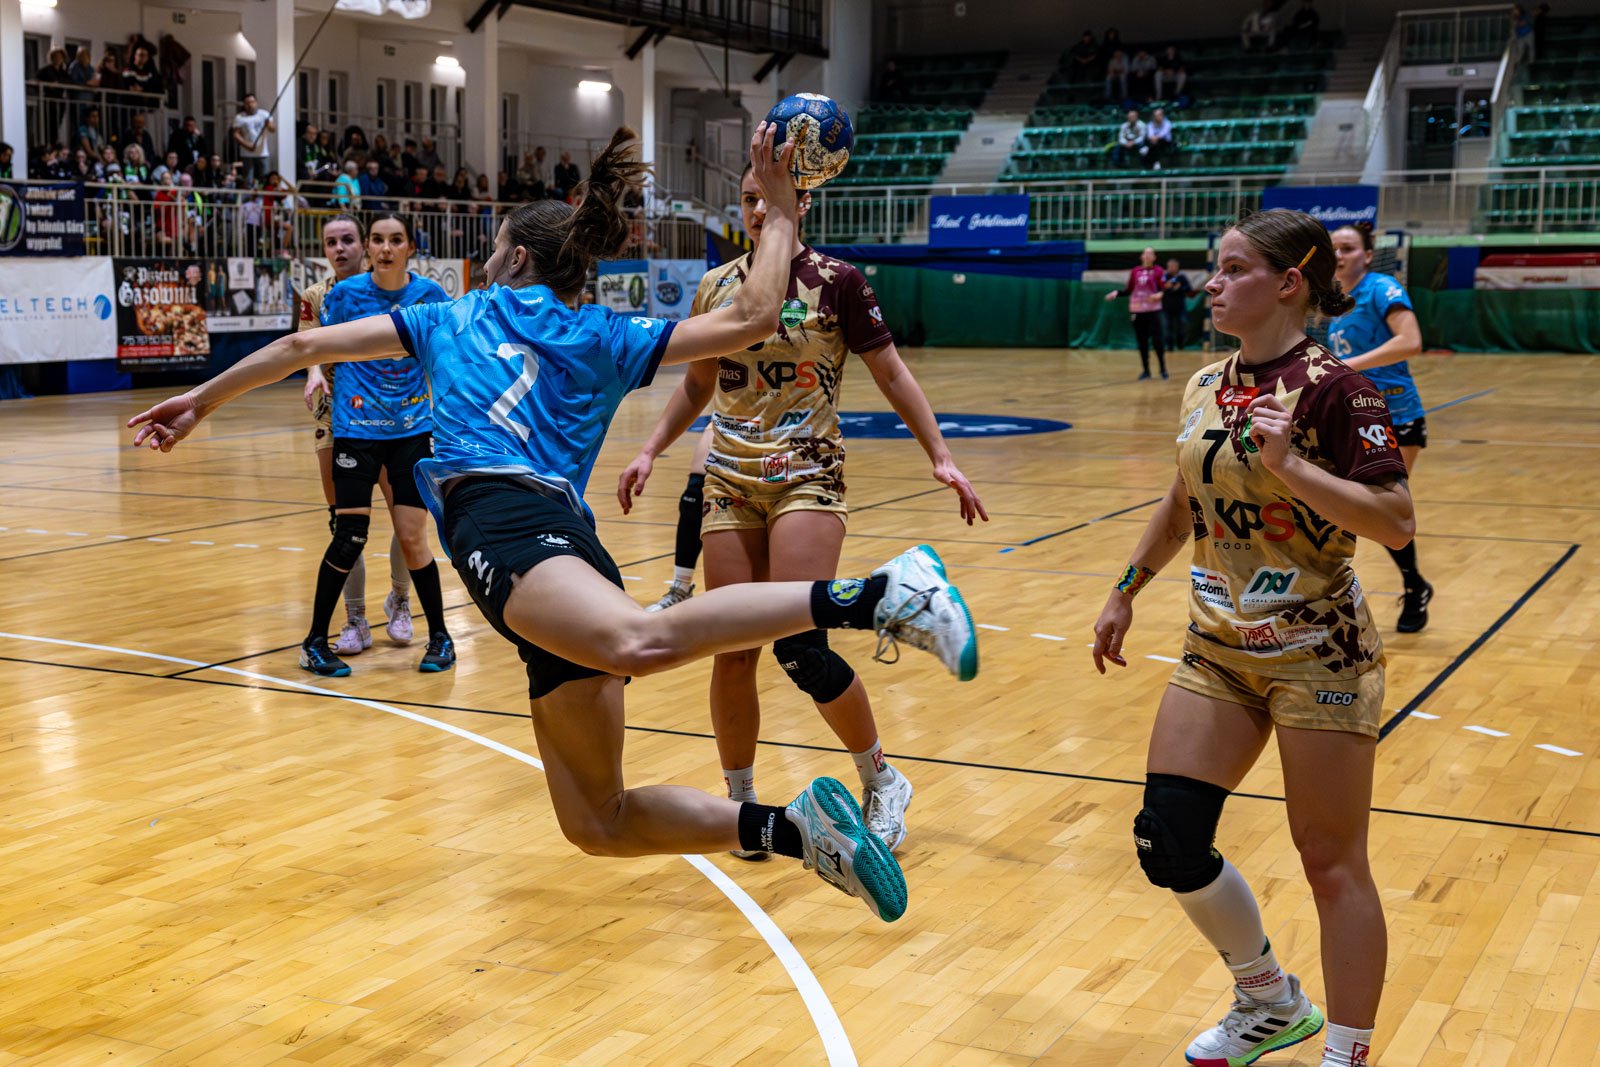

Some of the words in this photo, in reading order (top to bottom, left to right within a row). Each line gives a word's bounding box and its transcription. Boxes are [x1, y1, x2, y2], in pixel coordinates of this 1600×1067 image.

[756, 361, 817, 389] KPS
[1352, 394, 1386, 408] elmas
[1358, 425, 1398, 449] KPS
[1202, 429, 1231, 484] 7
[1214, 498, 1296, 542] KPS
[1214, 542, 1252, 550] FOOD
[1316, 691, 1353, 705] TICO
